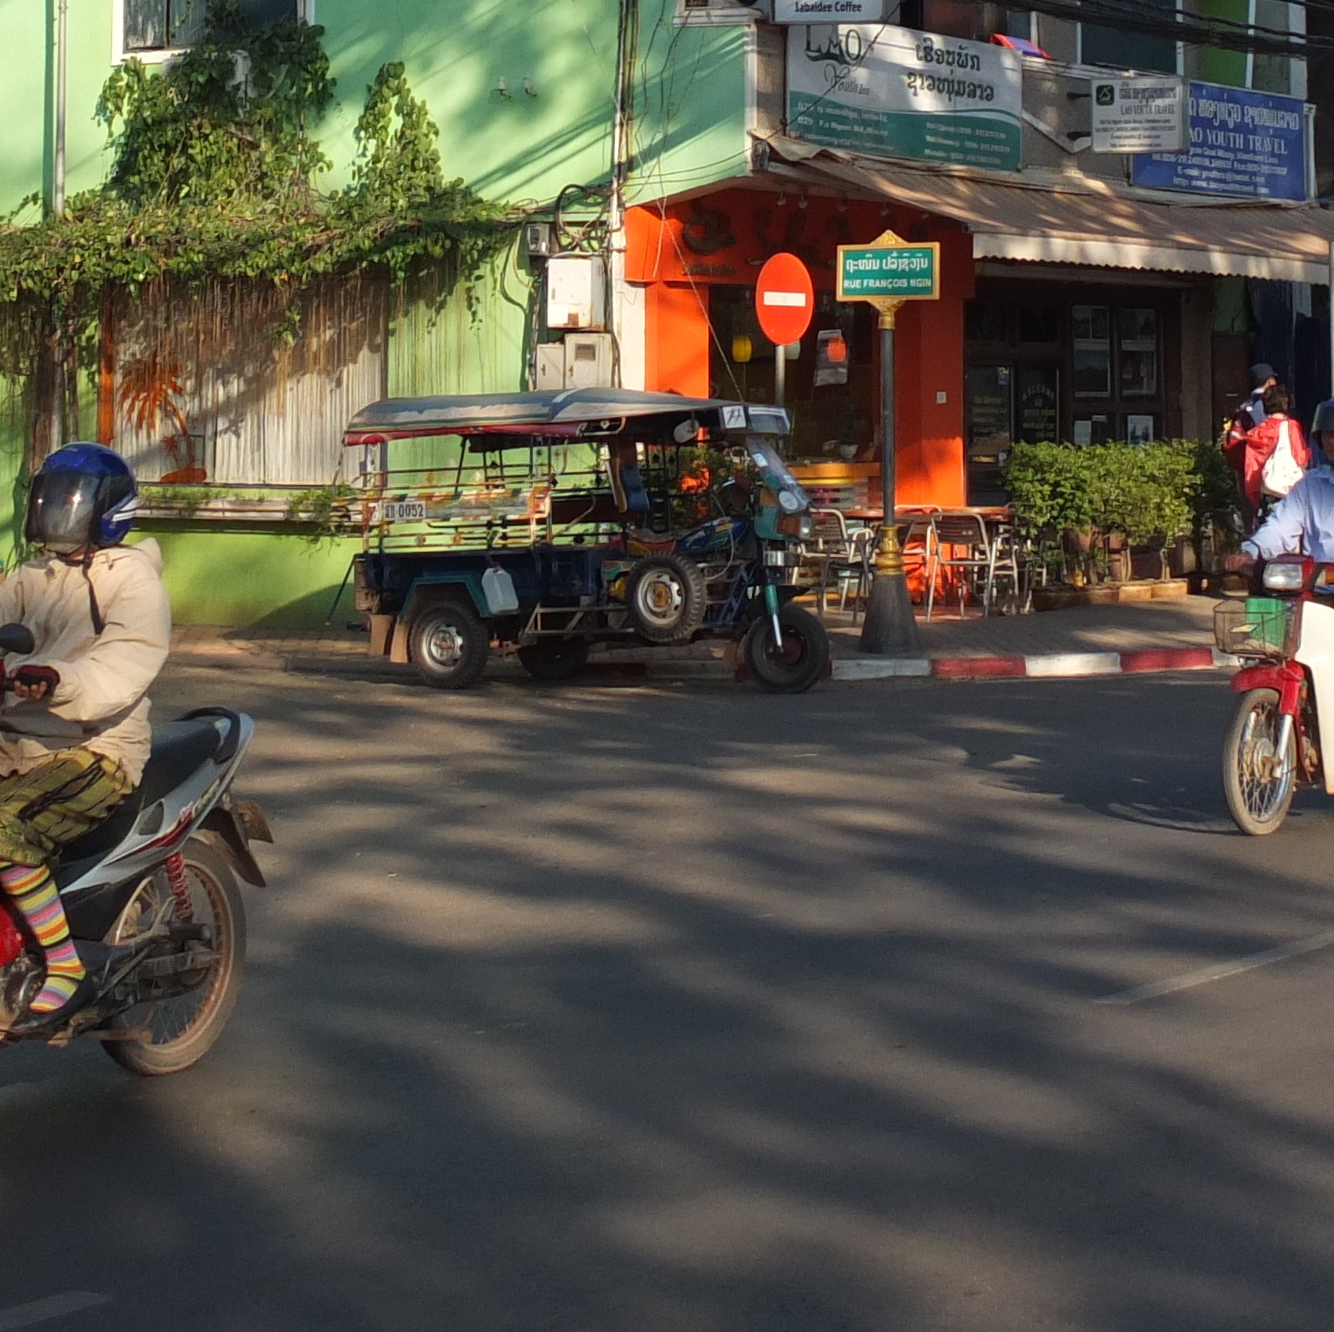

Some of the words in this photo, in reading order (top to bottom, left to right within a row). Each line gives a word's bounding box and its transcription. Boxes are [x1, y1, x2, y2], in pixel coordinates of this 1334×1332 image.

[794, 1, 833, 13] Sabaidee
[834, 0, 862, 12] Coffee
[1207, 128, 1244, 150] YOUTH
[1249, 135, 1288, 155] TRAVEL
[844, 279, 862, 289] RUE
[863, 278, 908, 289] FRANÇOIS
